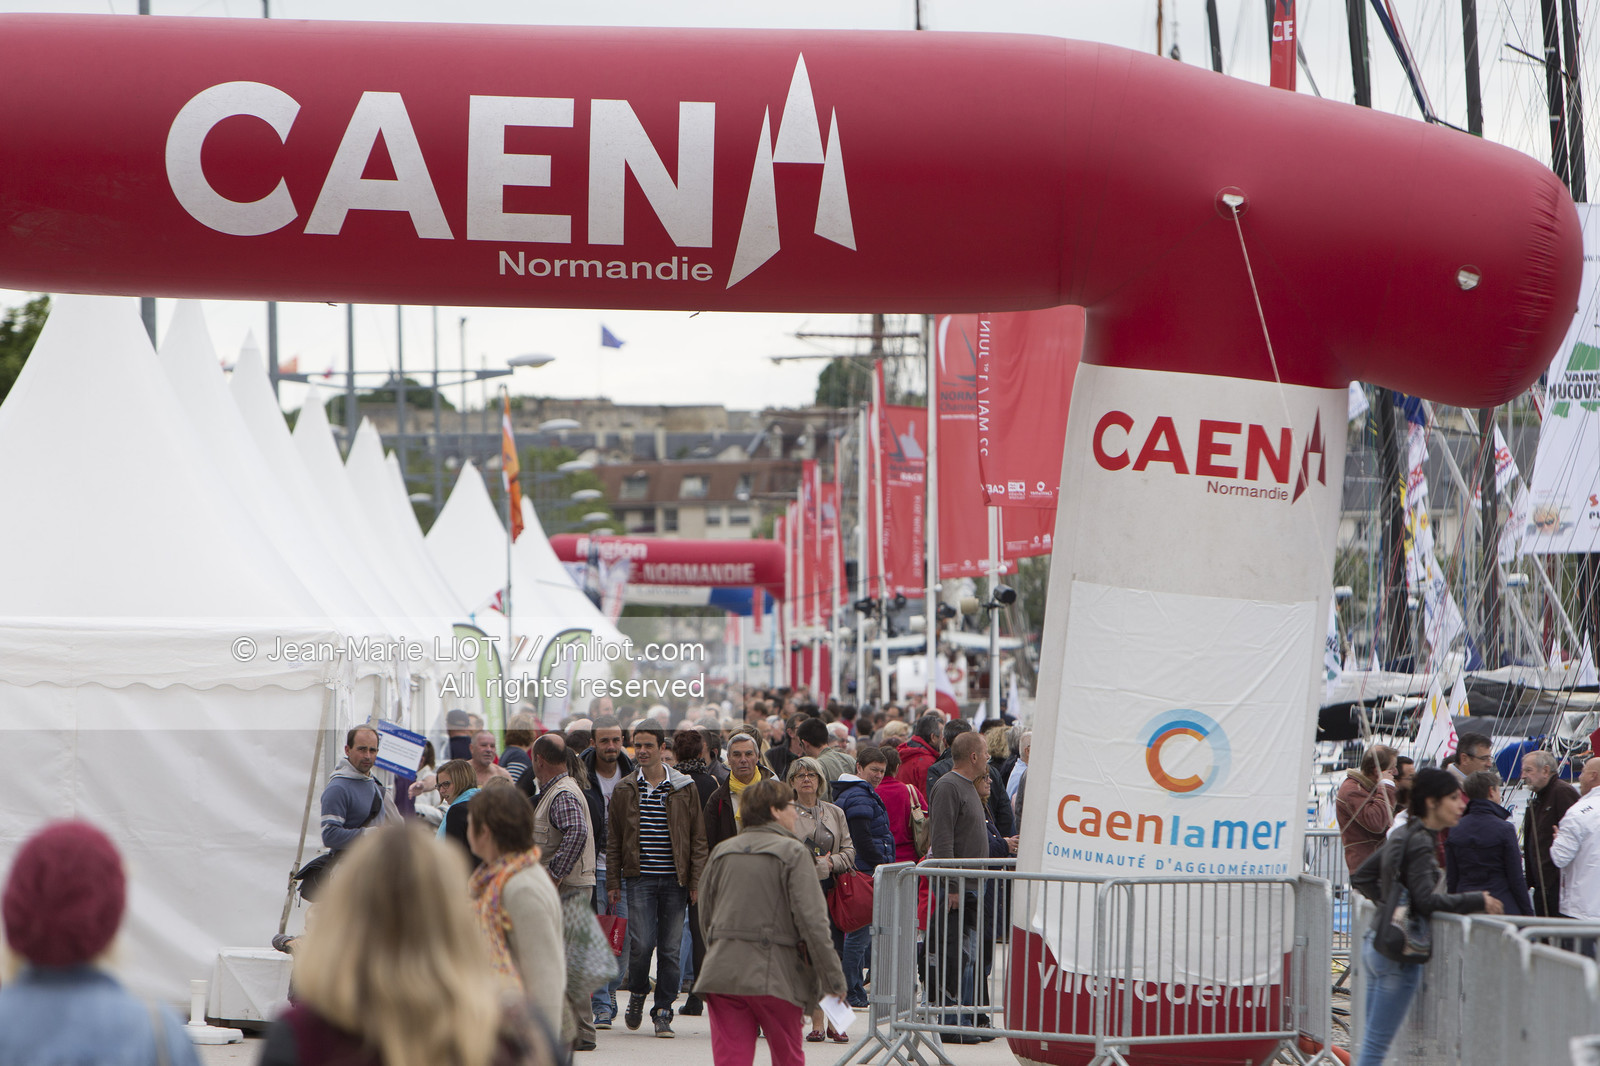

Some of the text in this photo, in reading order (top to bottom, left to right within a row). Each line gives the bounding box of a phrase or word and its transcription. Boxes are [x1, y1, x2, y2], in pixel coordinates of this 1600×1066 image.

[165, 81, 716, 248] CAEN
[499, 251, 713, 281] Normandie
[1093, 410, 1293, 484] CAEN
[1206, 480, 1289, 501] Normandie
[576, 538, 648, 560] Rgion
[1046, 841, 1288, 875] COMMUNAUTÉ D'AGGLOMÉRATION
